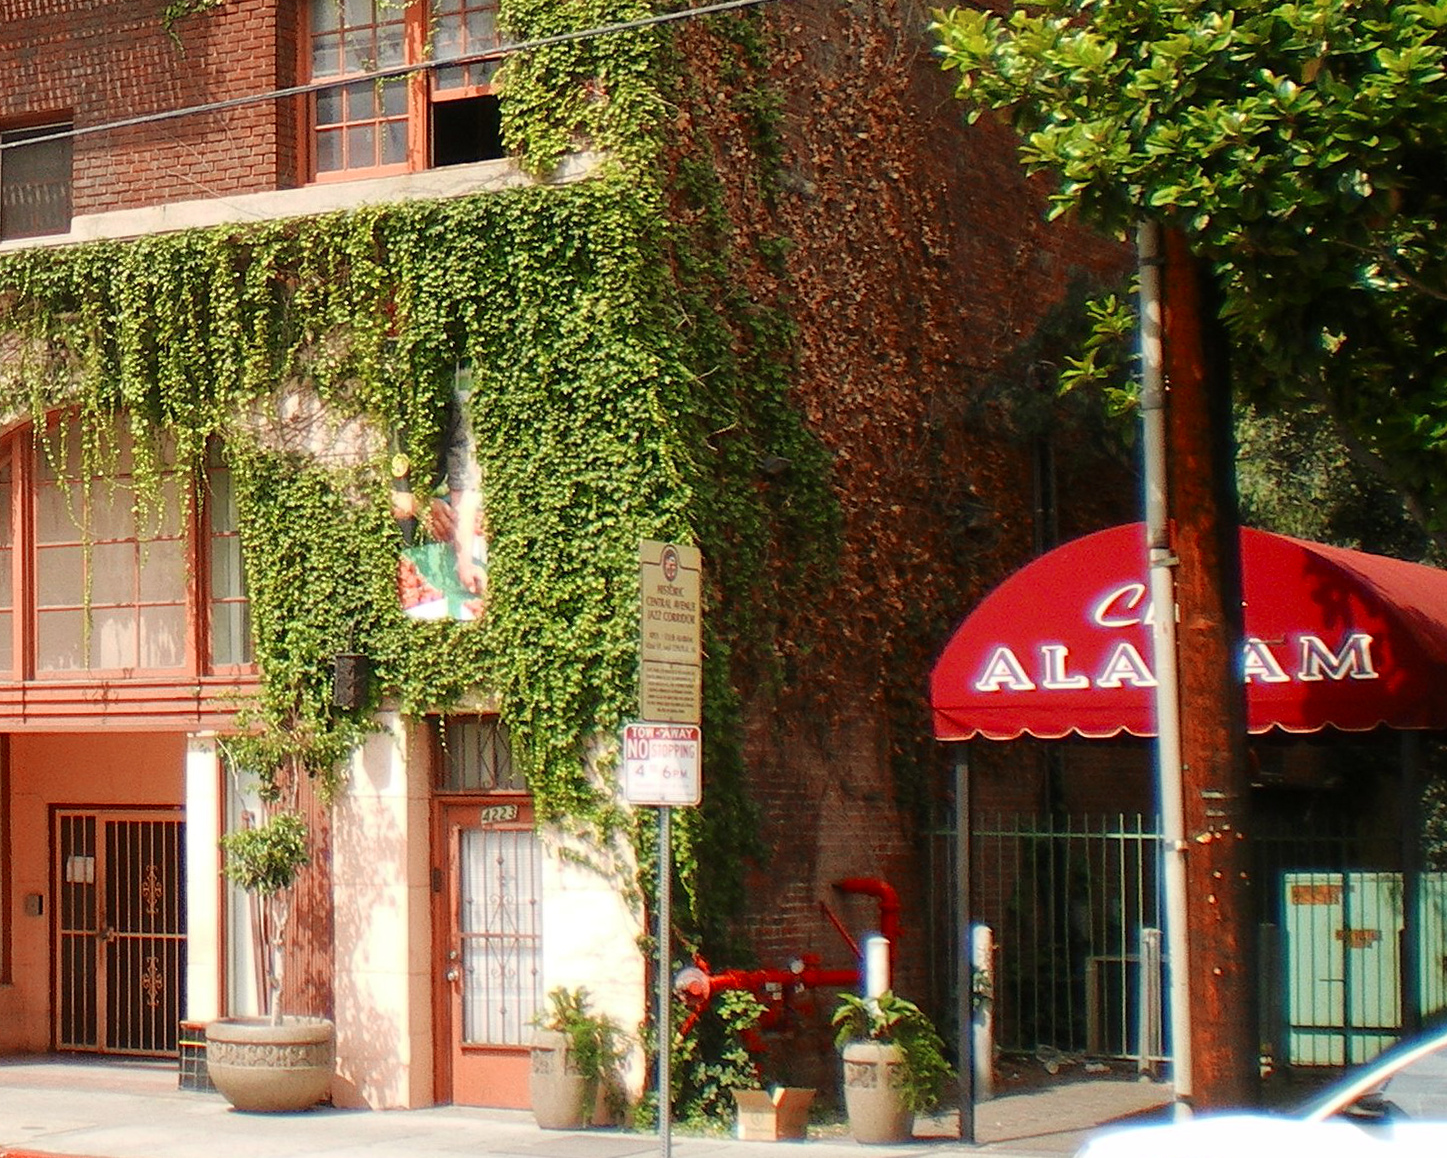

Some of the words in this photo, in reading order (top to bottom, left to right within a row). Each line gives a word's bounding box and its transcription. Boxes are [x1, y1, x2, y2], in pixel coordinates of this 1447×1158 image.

[975, 633, 1379, 692] ALAAM
[627, 739, 649, 759] NO
[651, 744, 695, 759] STOPPING
[635, 764, 645, 778] 4
[482, 805, 518, 822] 4223
